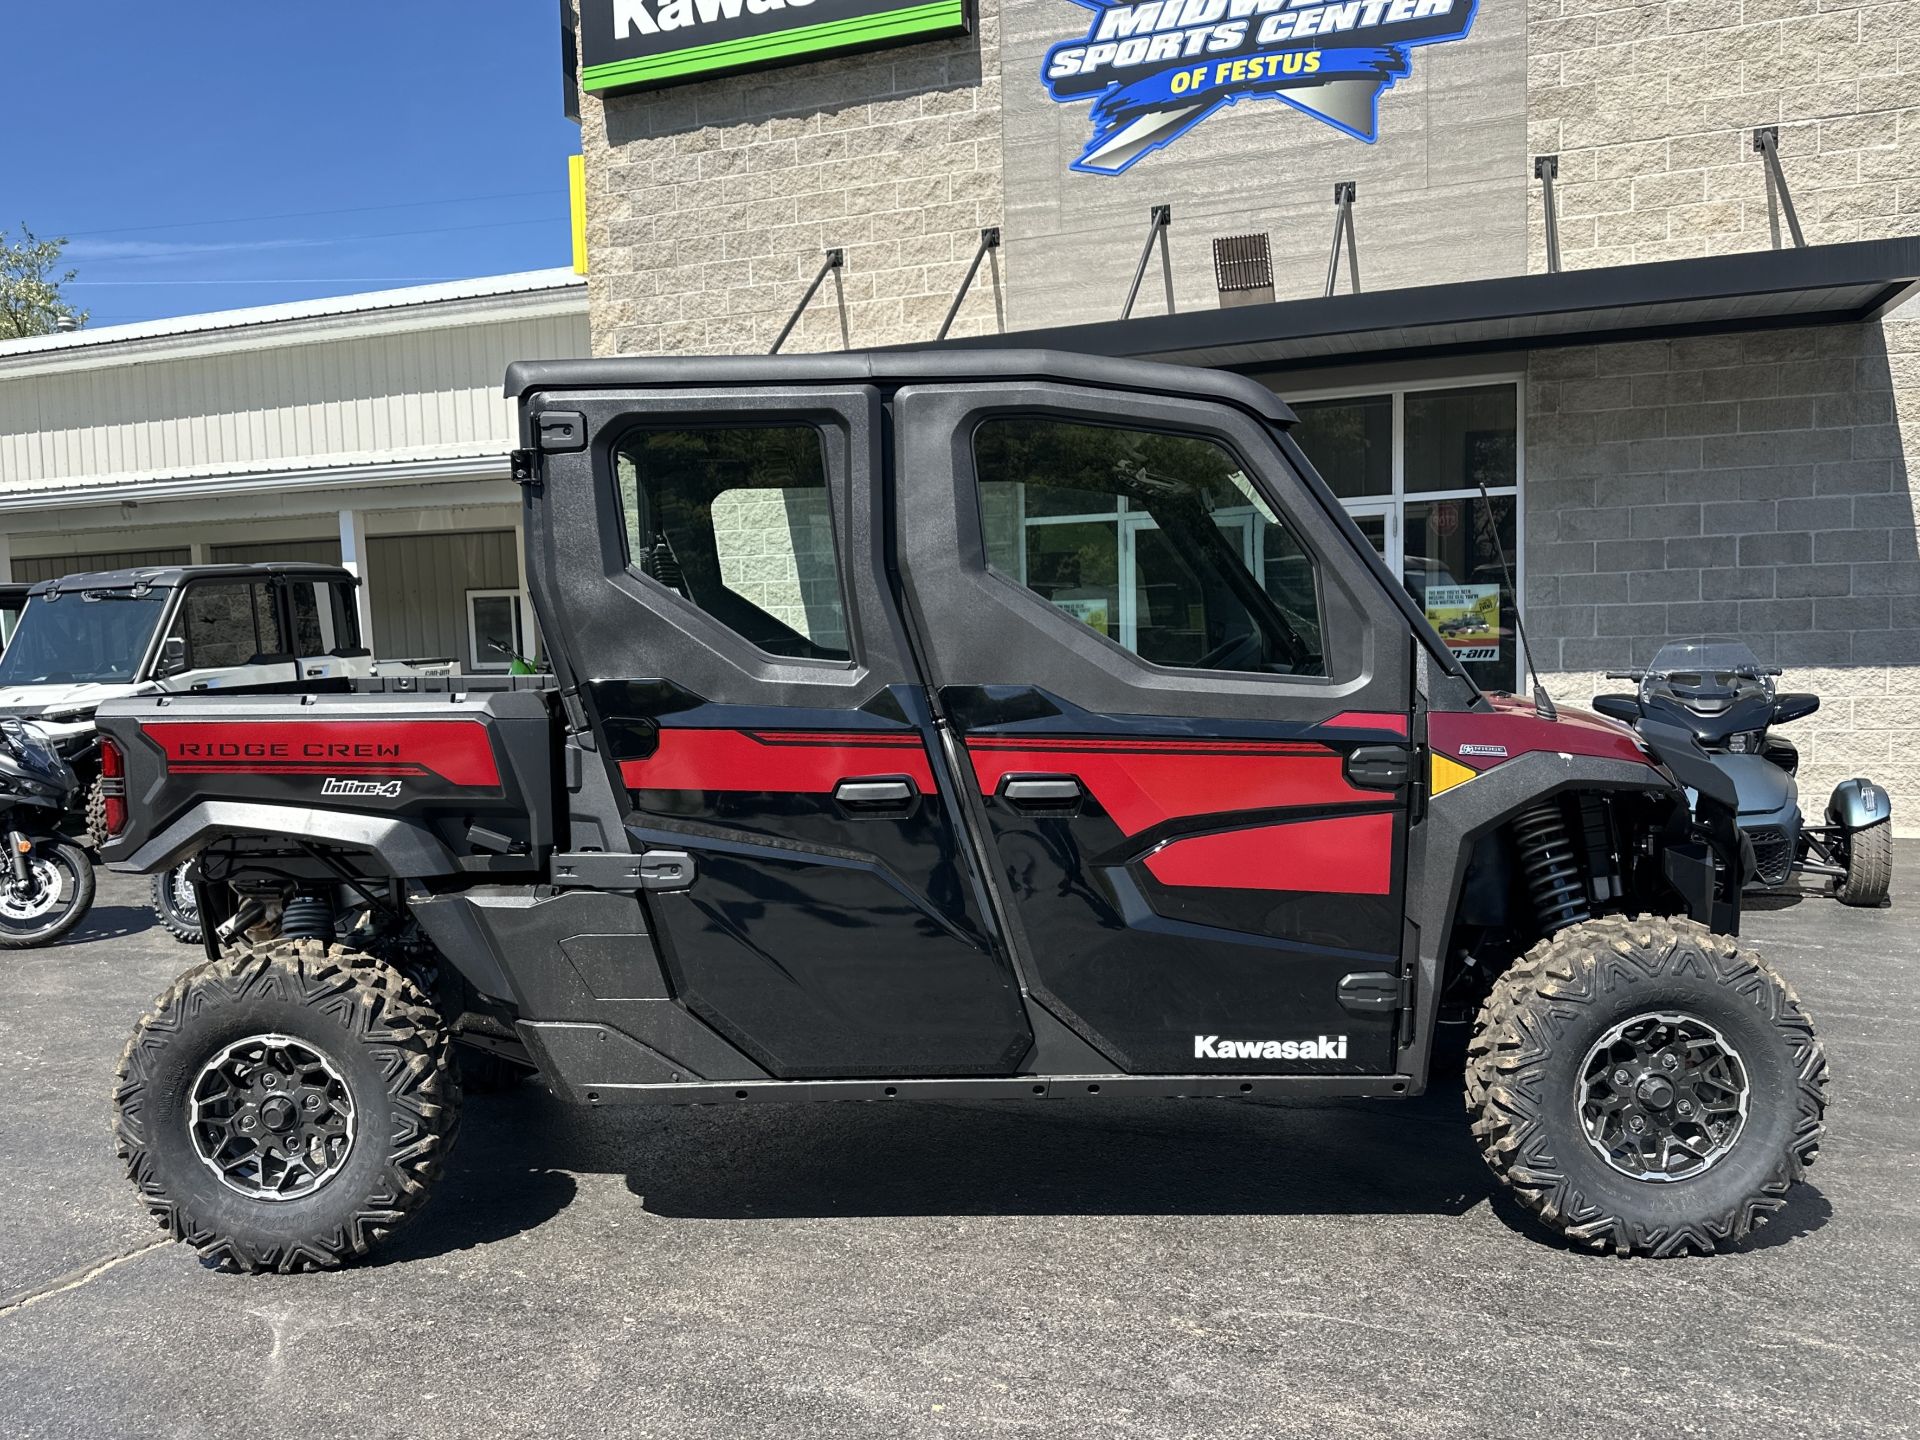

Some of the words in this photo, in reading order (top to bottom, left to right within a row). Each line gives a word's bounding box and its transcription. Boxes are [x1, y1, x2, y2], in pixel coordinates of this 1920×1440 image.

[613, 0, 817, 40] Kaw
[1096, 0, 1322, 40] MID
[1048, 19, 1249, 79] SPORTS
[1256, 0, 1452, 45] CENTER
[1170, 68, 1207, 94] OF
[1215, 51, 1321, 85] FESTUS
[1452, 649, 1496, 659] n-am
[180, 743, 289, 757] RIDGE
[303, 743, 400, 757] CREW
[321, 778, 402, 797] Inline-4
[1194, 1035, 1348, 1059] Kawasaki
